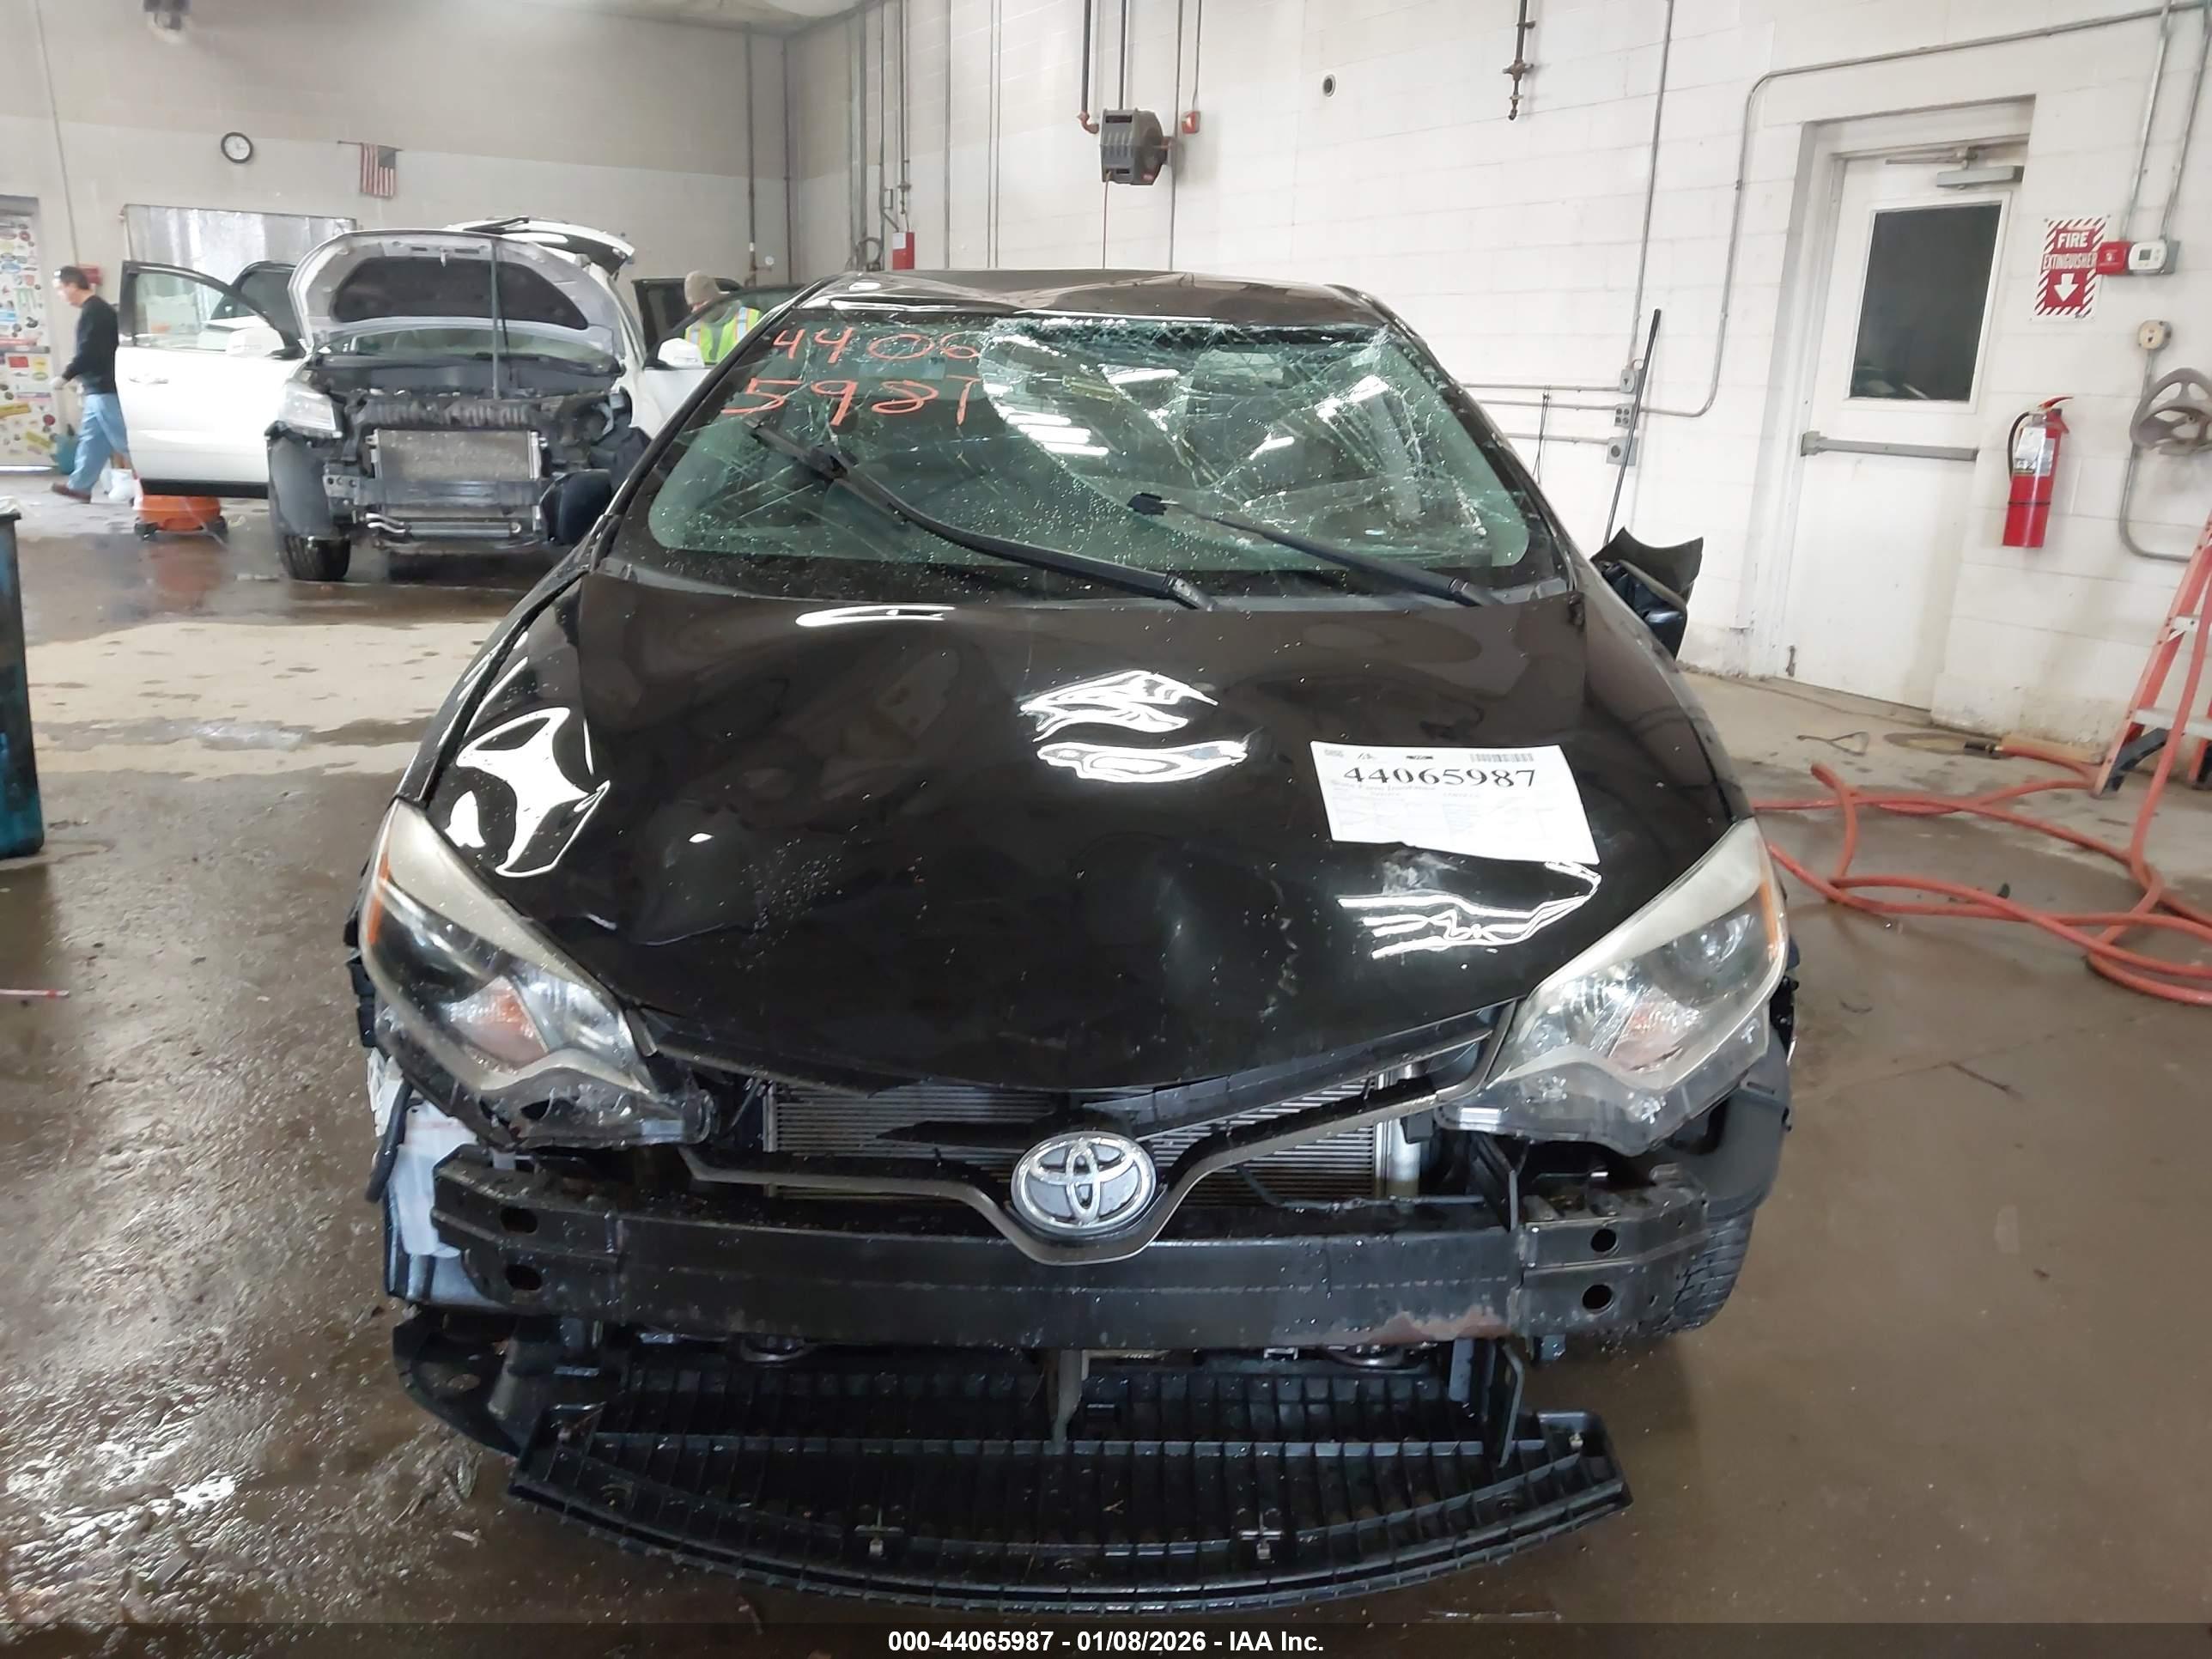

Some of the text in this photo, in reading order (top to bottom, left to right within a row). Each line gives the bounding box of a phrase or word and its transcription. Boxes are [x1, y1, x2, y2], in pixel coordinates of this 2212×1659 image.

[2057, 232, 2089, 249] FIRE
[2042, 252, 2098, 270] EXTINGUISHER
[773, 326, 981, 364] 4406
[721, 374, 981, 426] 5987
[1344, 767, 1535, 787] 44065987
